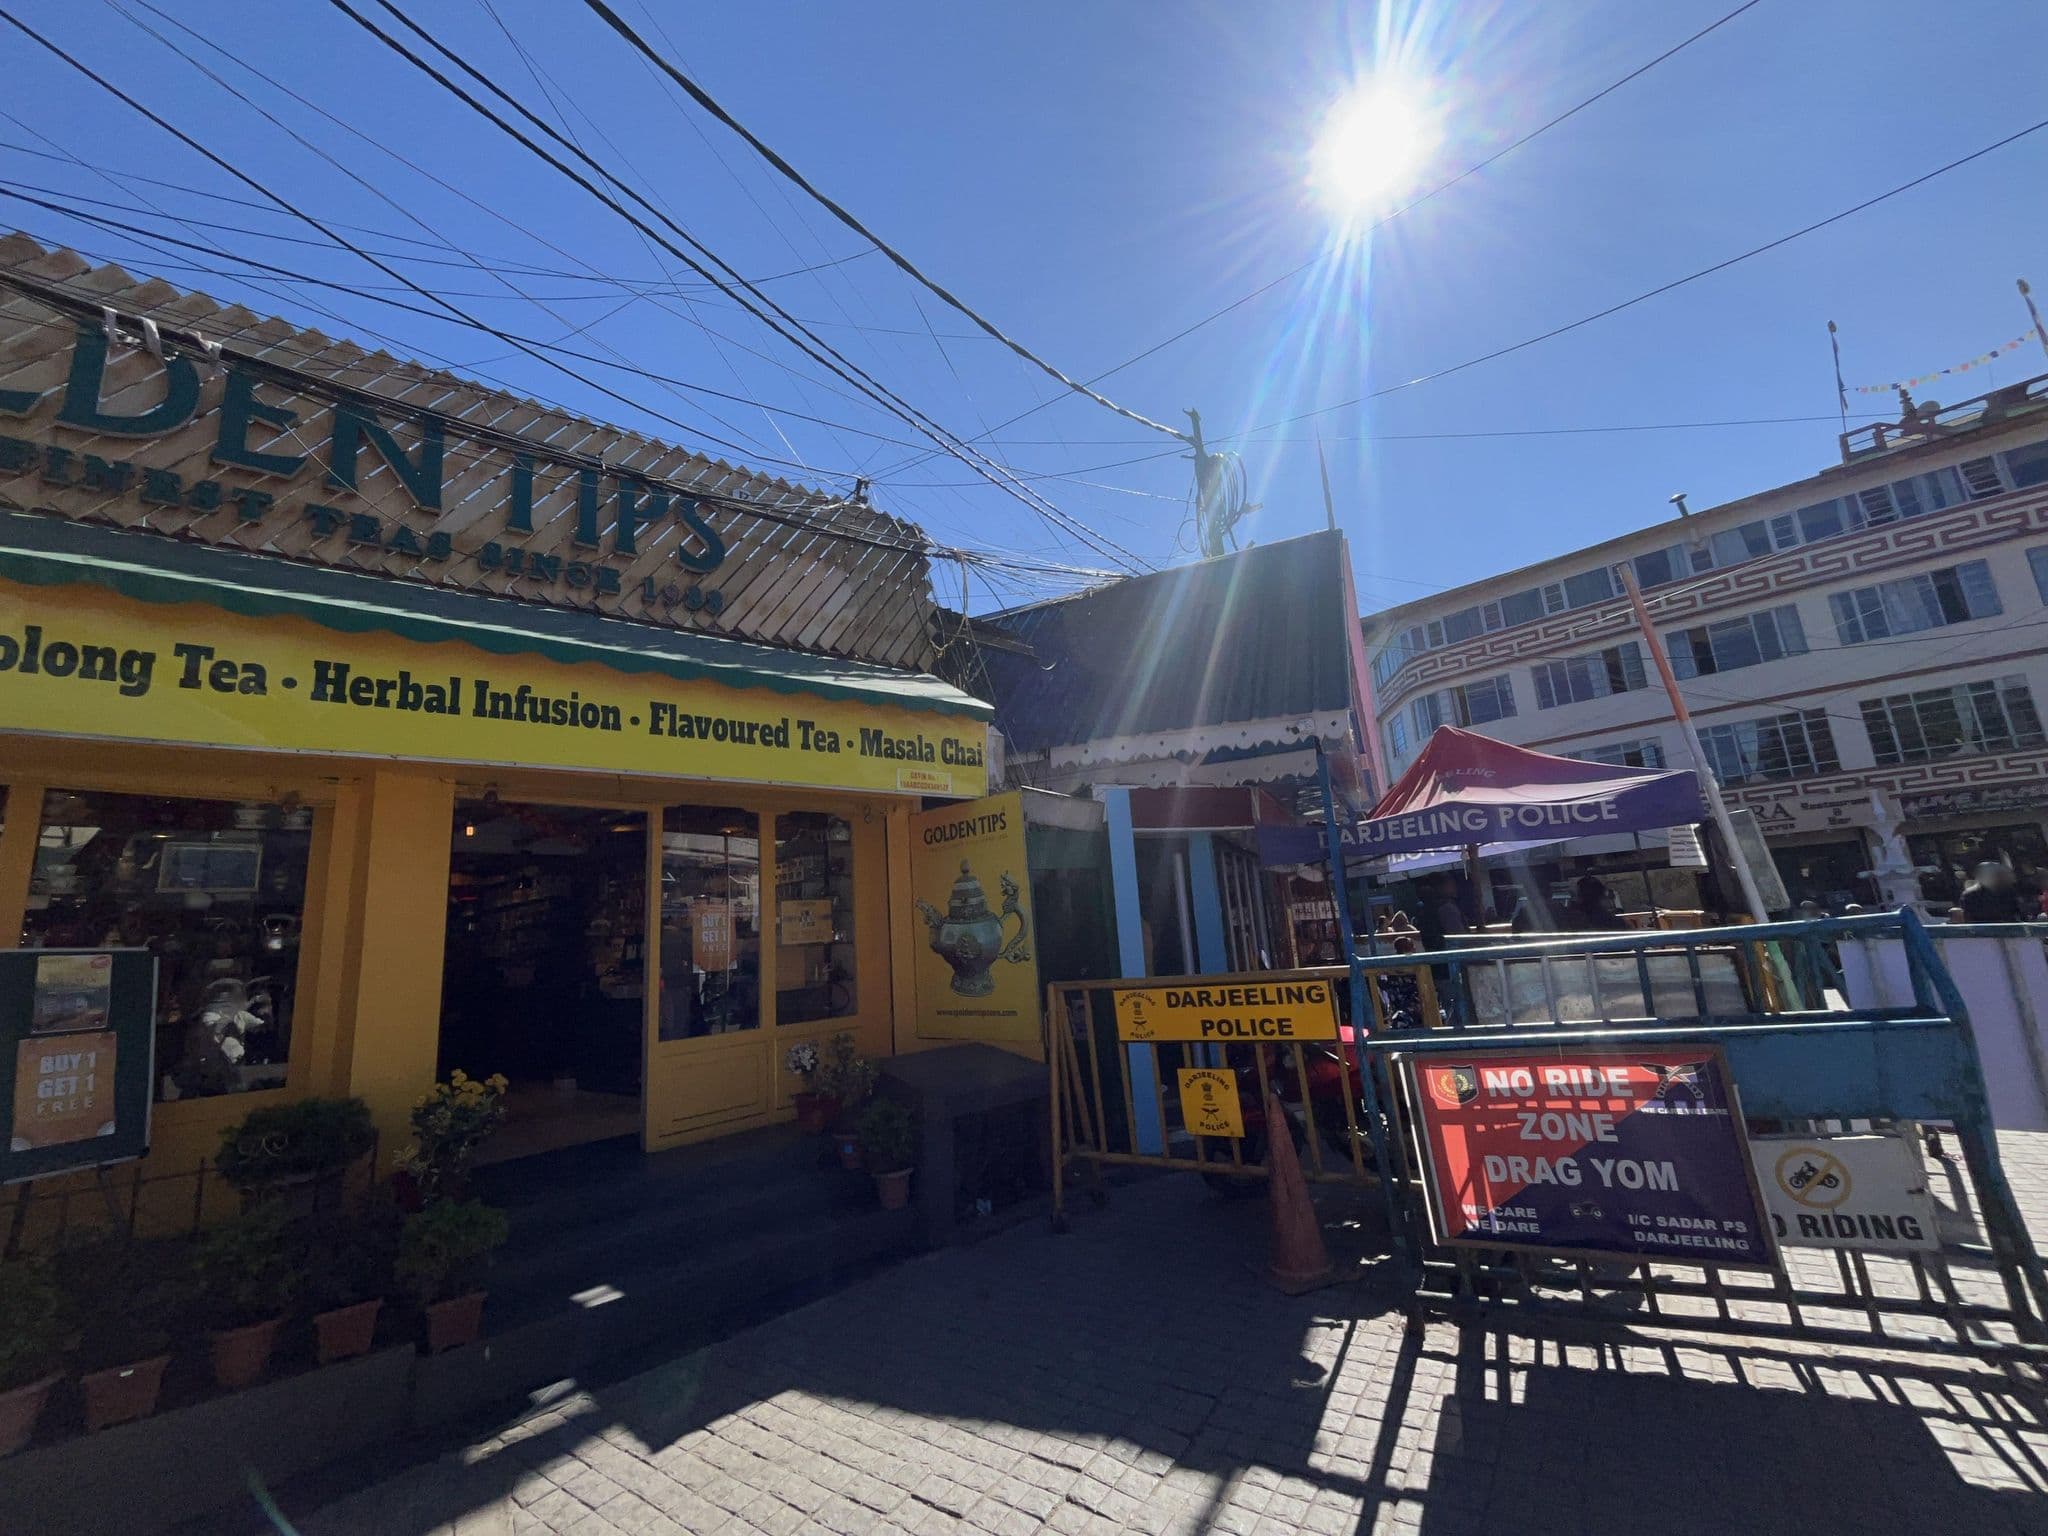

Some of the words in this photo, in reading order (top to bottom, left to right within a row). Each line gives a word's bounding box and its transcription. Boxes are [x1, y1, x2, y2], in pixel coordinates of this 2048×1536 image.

[0, 318, 450, 516] DEN
[304, 504, 451, 561] TEAS
[479, 542, 621, 596] SINCE
[173, 643, 267, 696] Tea
[310, 660, 461, 717] Herbal
[472, 679, 622, 732] Infusion
[648, 701, 790, 749] Flavoured
[797, 719, 841, 754] Tea
[860, 727, 936, 763] Masala
[941, 735, 984, 768] Chai
[1499, 798, 1619, 829] POLICE
[923, 818, 977, 845] GOLDEN
[978, 812, 1007, 835] TIPS
[1165, 985, 1326, 1009] DARJEELING
[1201, 1018, 1294, 1037] POLICE
[40, 1053, 81, 1074] BUY
[37, 1076, 79, 1100] GET
[1184, 1071, 1231, 1091] DARJEELING
[1485, 1067, 1534, 1098] NO
[1545, 1067, 1635, 1098] RIDE
[37, 1099, 94, 1115] FREE
[1199, 1121, 1231, 1131] POLICE
[1517, 1112, 1619, 1143] ZONE
[1484, 1154, 1581, 1186] DRAG
[1589, 1158, 1680, 1192] YOM
[1462, 1204, 1488, 1216] WE
[1493, 1206, 1538, 1219] CARE
[1466, 1219, 1492, 1232] WE
[1495, 1220, 1541, 1234] DARE
[1656, 1215, 1718, 1231] SADAR
[1722, 1220, 1748, 1233] PS
[1797, 1213, 1924, 1241] RIDING
[1633, 1231, 1750, 1250] DARJEELING
